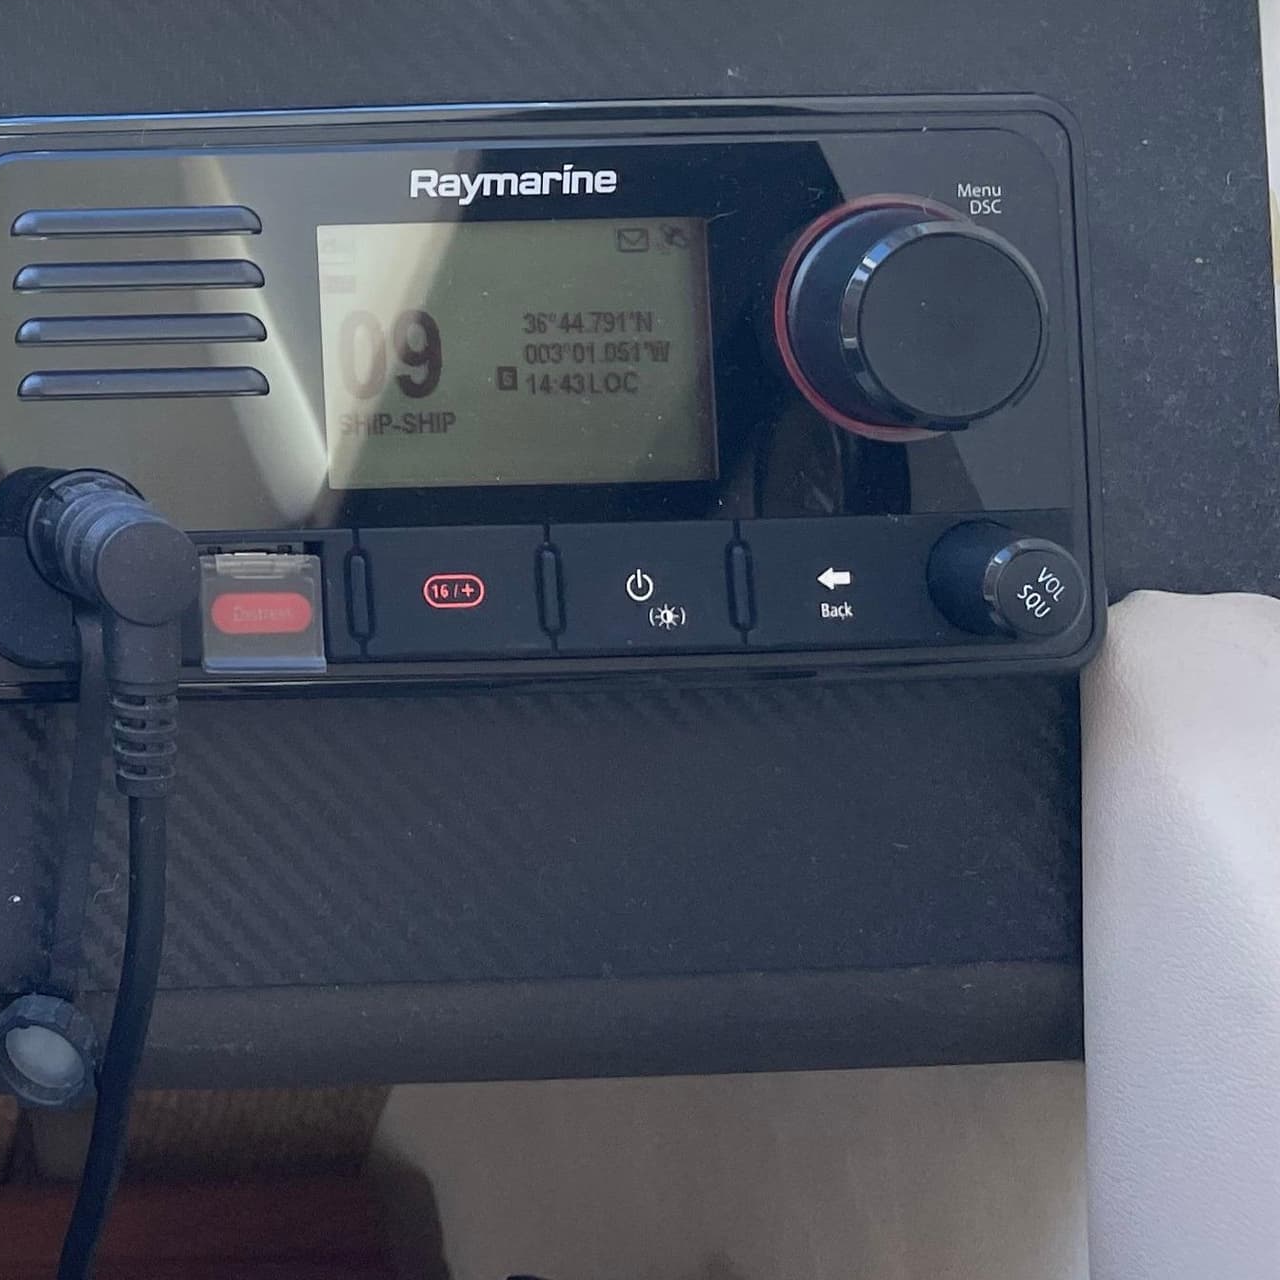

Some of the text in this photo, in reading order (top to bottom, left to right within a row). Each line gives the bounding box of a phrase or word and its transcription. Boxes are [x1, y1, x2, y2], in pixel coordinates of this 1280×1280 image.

[409, 164, 618, 206] Raymarine
[957, 183, 1002, 198] Menu
[970, 200, 1002, 215] DSC
[342, 309, 443, 400] 09
[590, 371, 639, 395] LOC
[341, 411, 457, 435] SHIP-SHIP
[1037, 567, 1066, 602] VOL
[820, 602, 853, 620] Back
[1016, 584, 1051, 619] SQU
